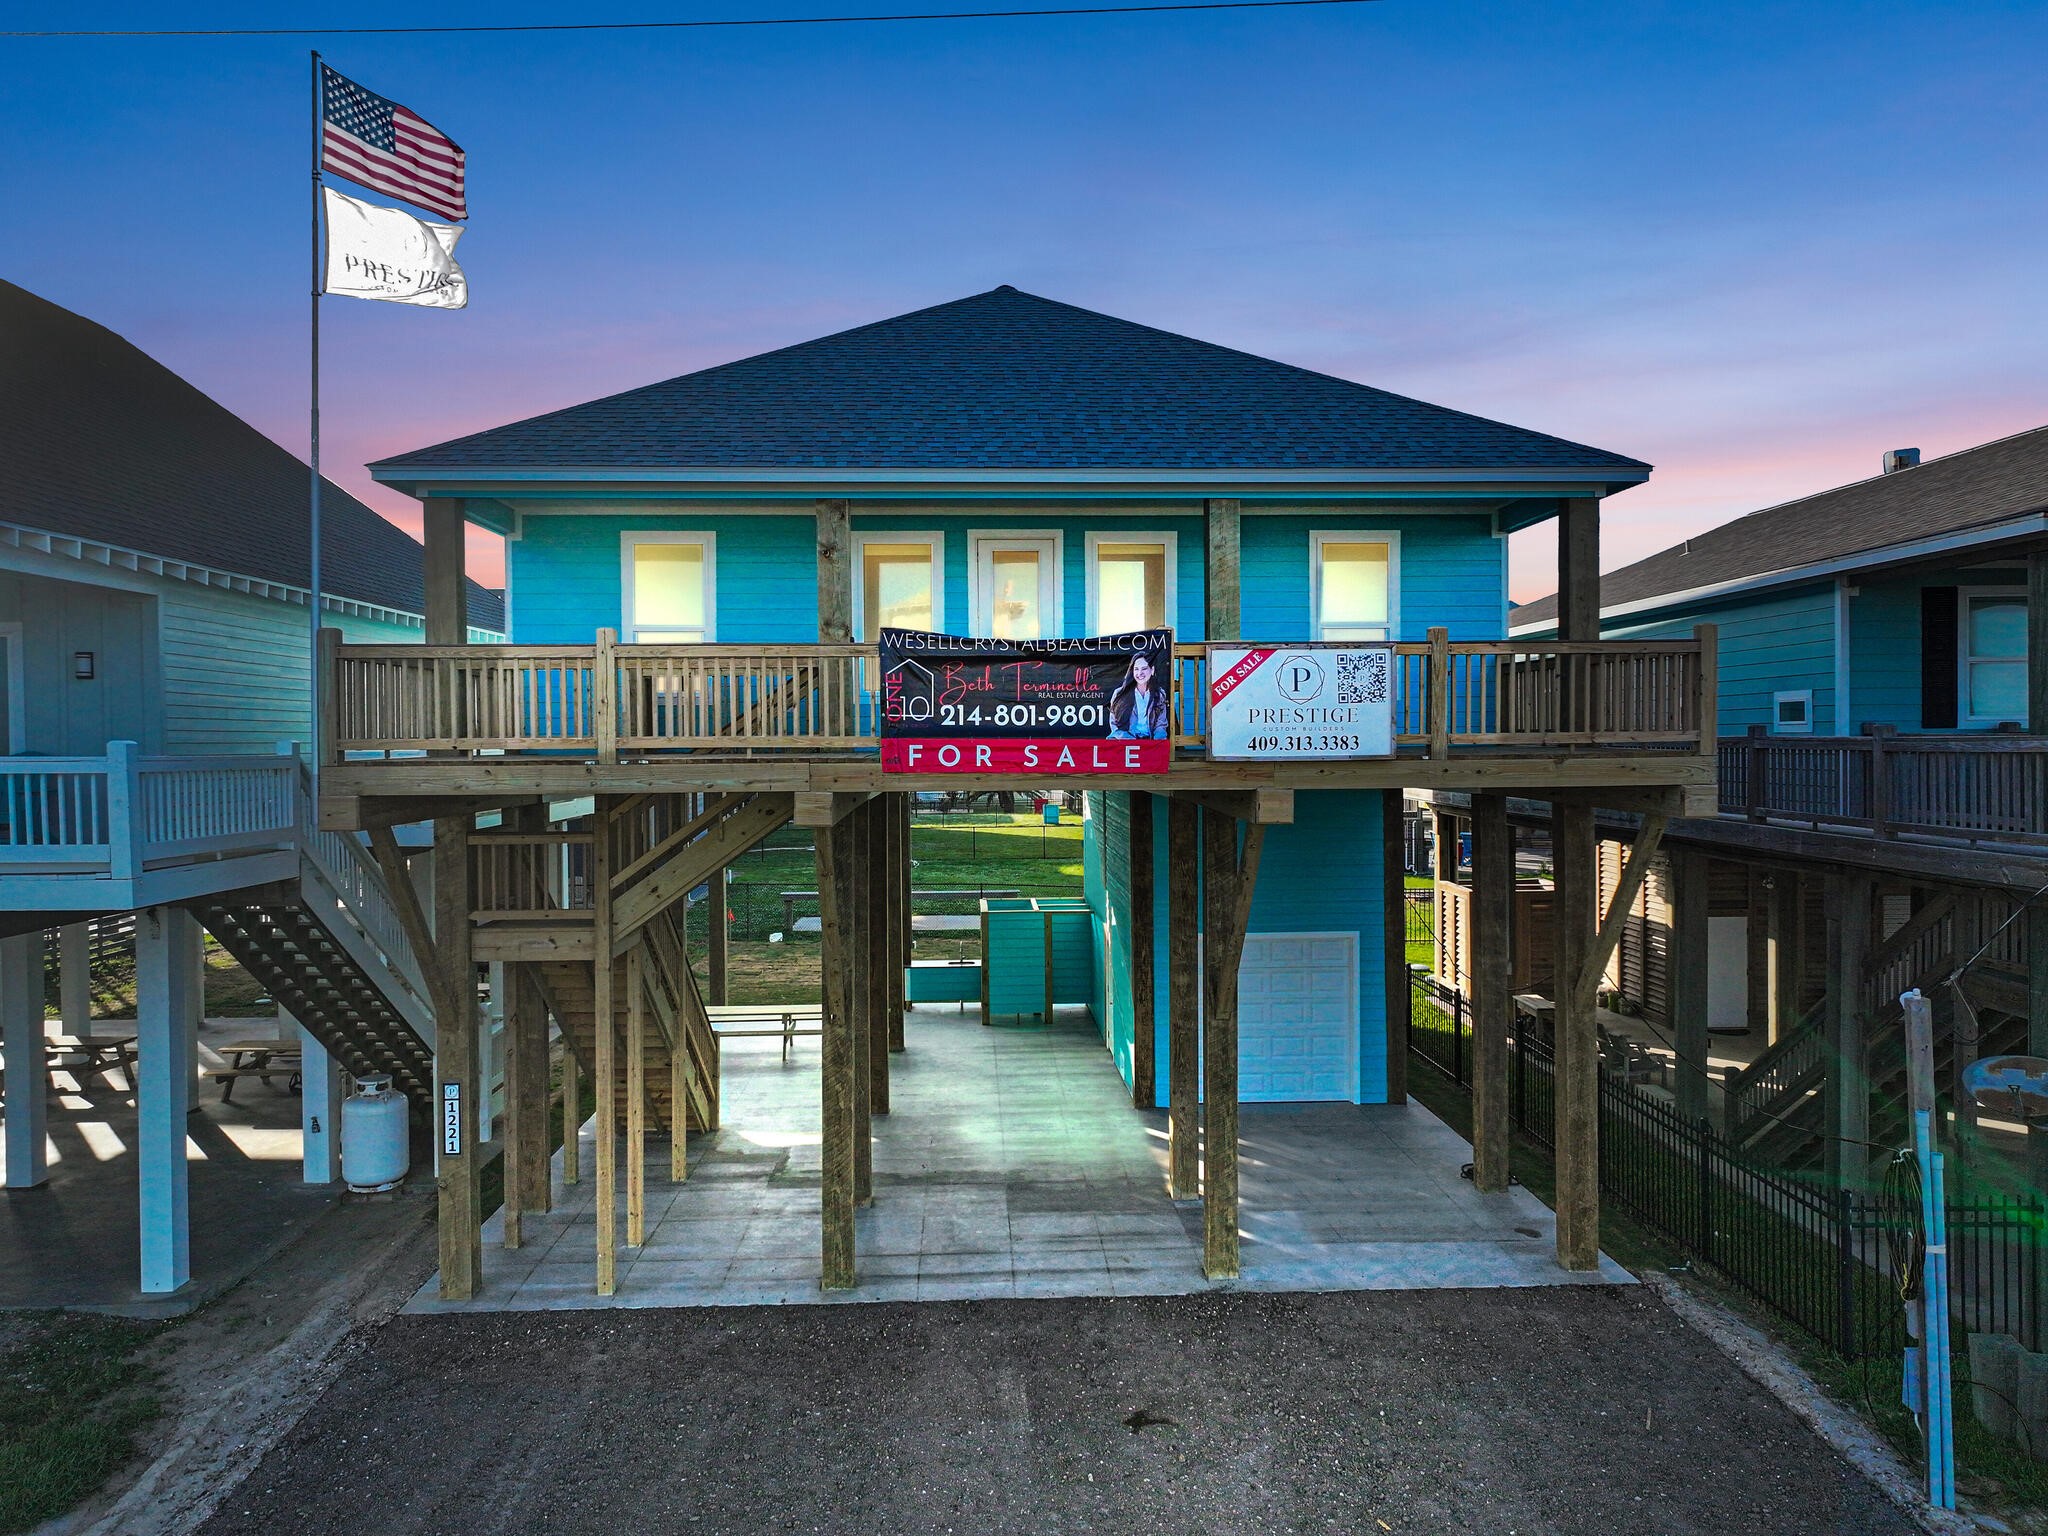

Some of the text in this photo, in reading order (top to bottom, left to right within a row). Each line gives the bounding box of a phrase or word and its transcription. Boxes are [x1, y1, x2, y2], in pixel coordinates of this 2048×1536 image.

[882, 632, 1167, 651] WESELLCRYSTALBEACH.COM
[939, 660, 1102, 706] Beth Terminella
[1214, 652, 1264, 696] FOR SALE
[1291, 667, 1311, 692] P
[886, 671, 903, 722] ONE
[898, 696, 930, 721] 10
[940, 704, 1104, 727] 214-801-9801
[1249, 707, 1360, 723] PRESTIGE
[1247, 735, 1360, 751] 409.313.3383
[908, 744, 1141, 768] FOR SALE
[448, 1101, 457, 1152] 1221
